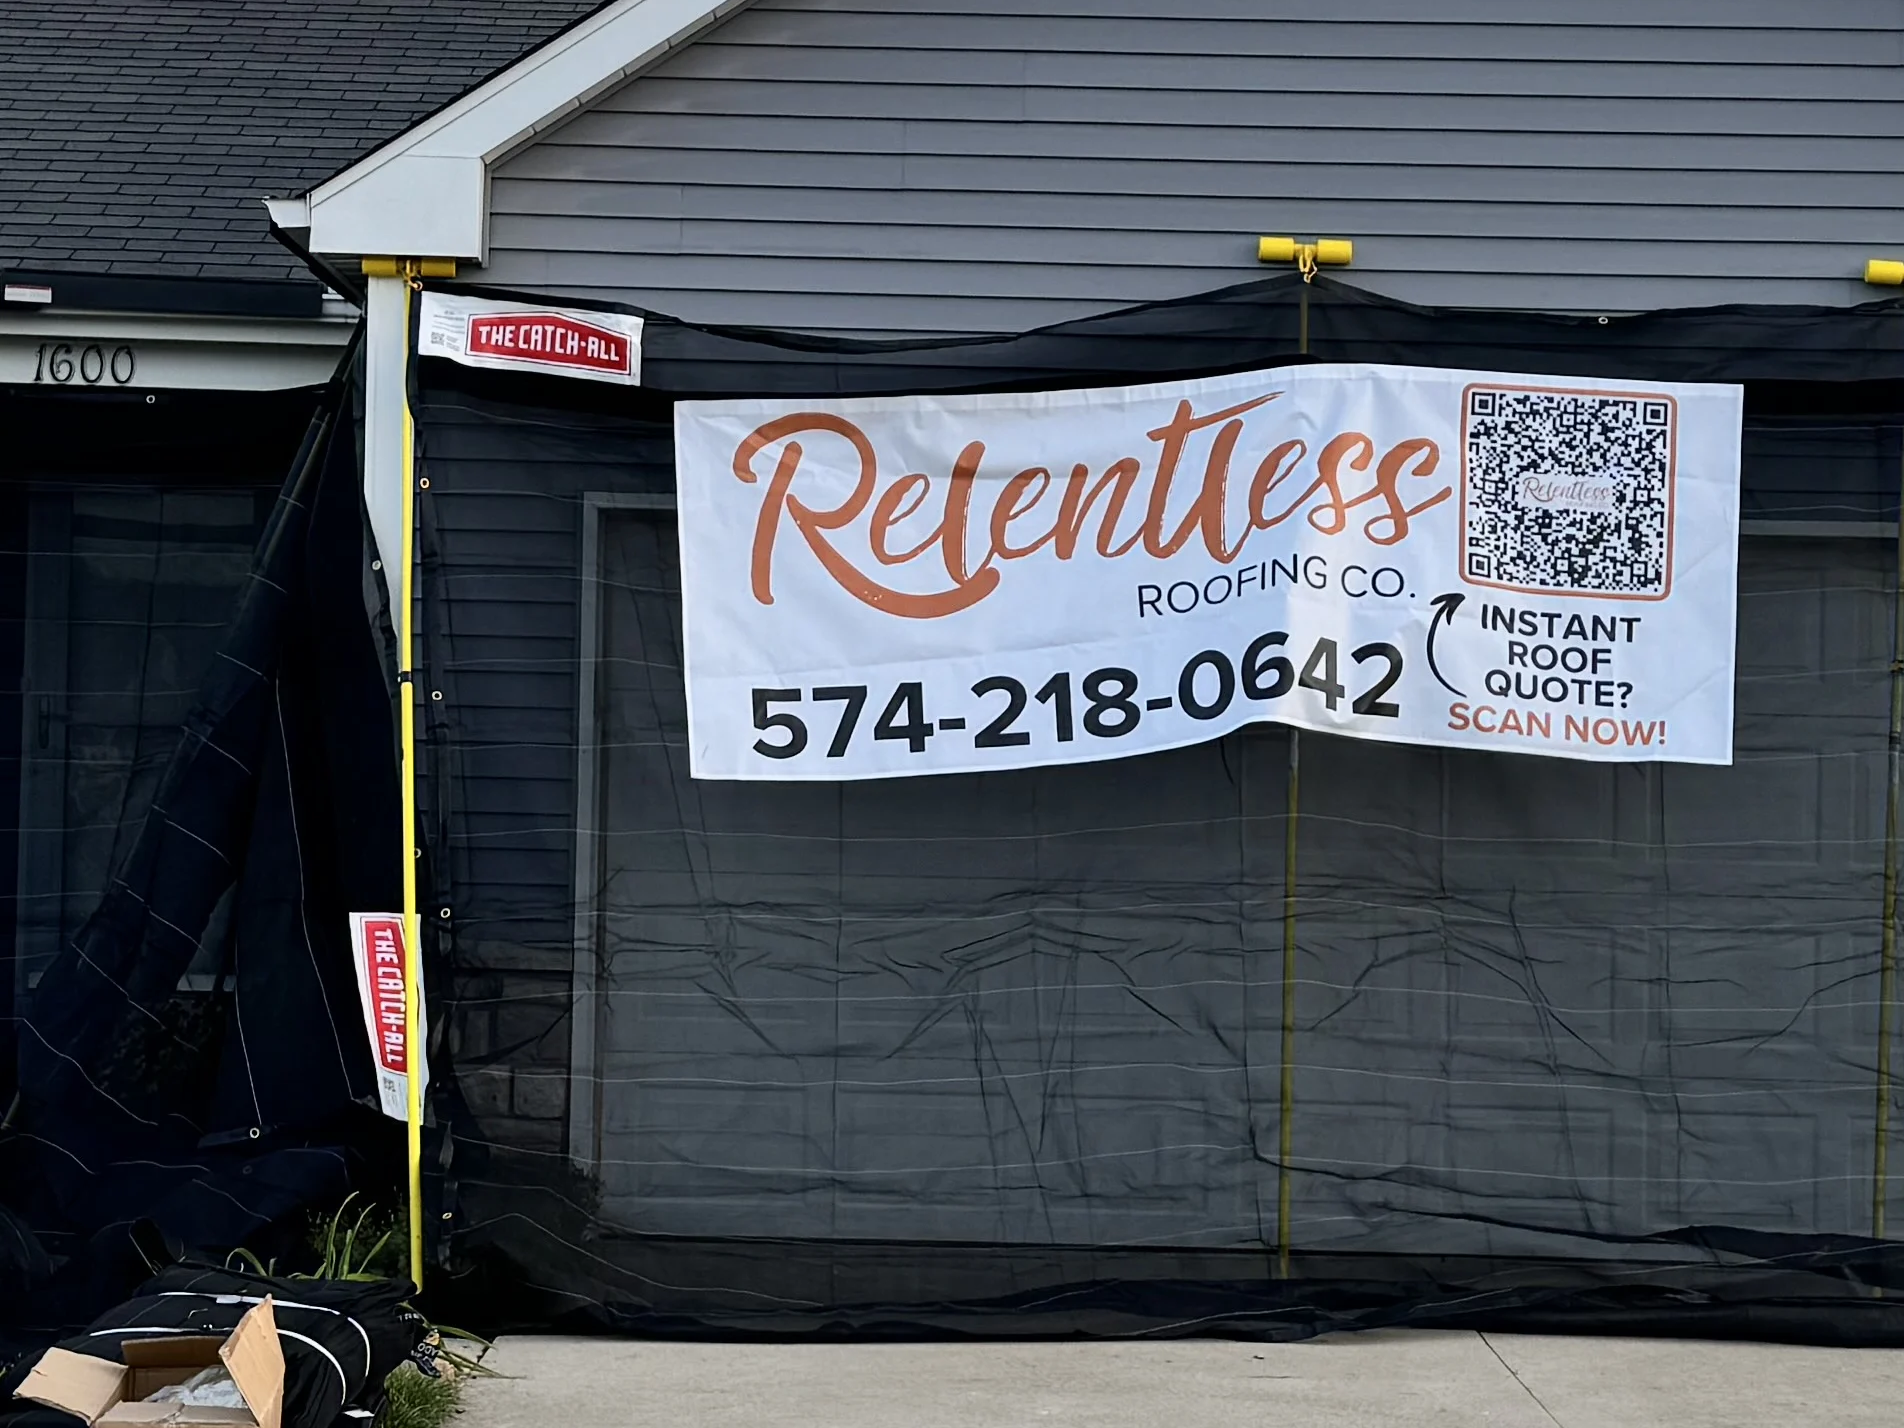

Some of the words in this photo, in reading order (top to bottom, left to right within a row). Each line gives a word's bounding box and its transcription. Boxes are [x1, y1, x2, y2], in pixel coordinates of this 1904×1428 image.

[33, 343, 136, 385] 1600
[478, 325, 515, 348] THE
[518, 324, 620, 362] CATCH-ALL
[731, 390, 1453, 619] Relentless
[1137, 554, 1328, 619] ROOFING
[1339, 564, 1416, 600] CO.
[1481, 604, 1642, 643] INSTANT
[1508, 640, 1612, 675] ROOF
[751, 629, 1402, 759] 574-218-0642
[1484, 668, 1634, 709] QUOTE?
[1447, 702, 1552, 739] SCAN
[1564, 713, 1667, 746] NOW!
[374, 927, 399, 964] THE
[377, 965, 407, 1064] CATCH-ALL
